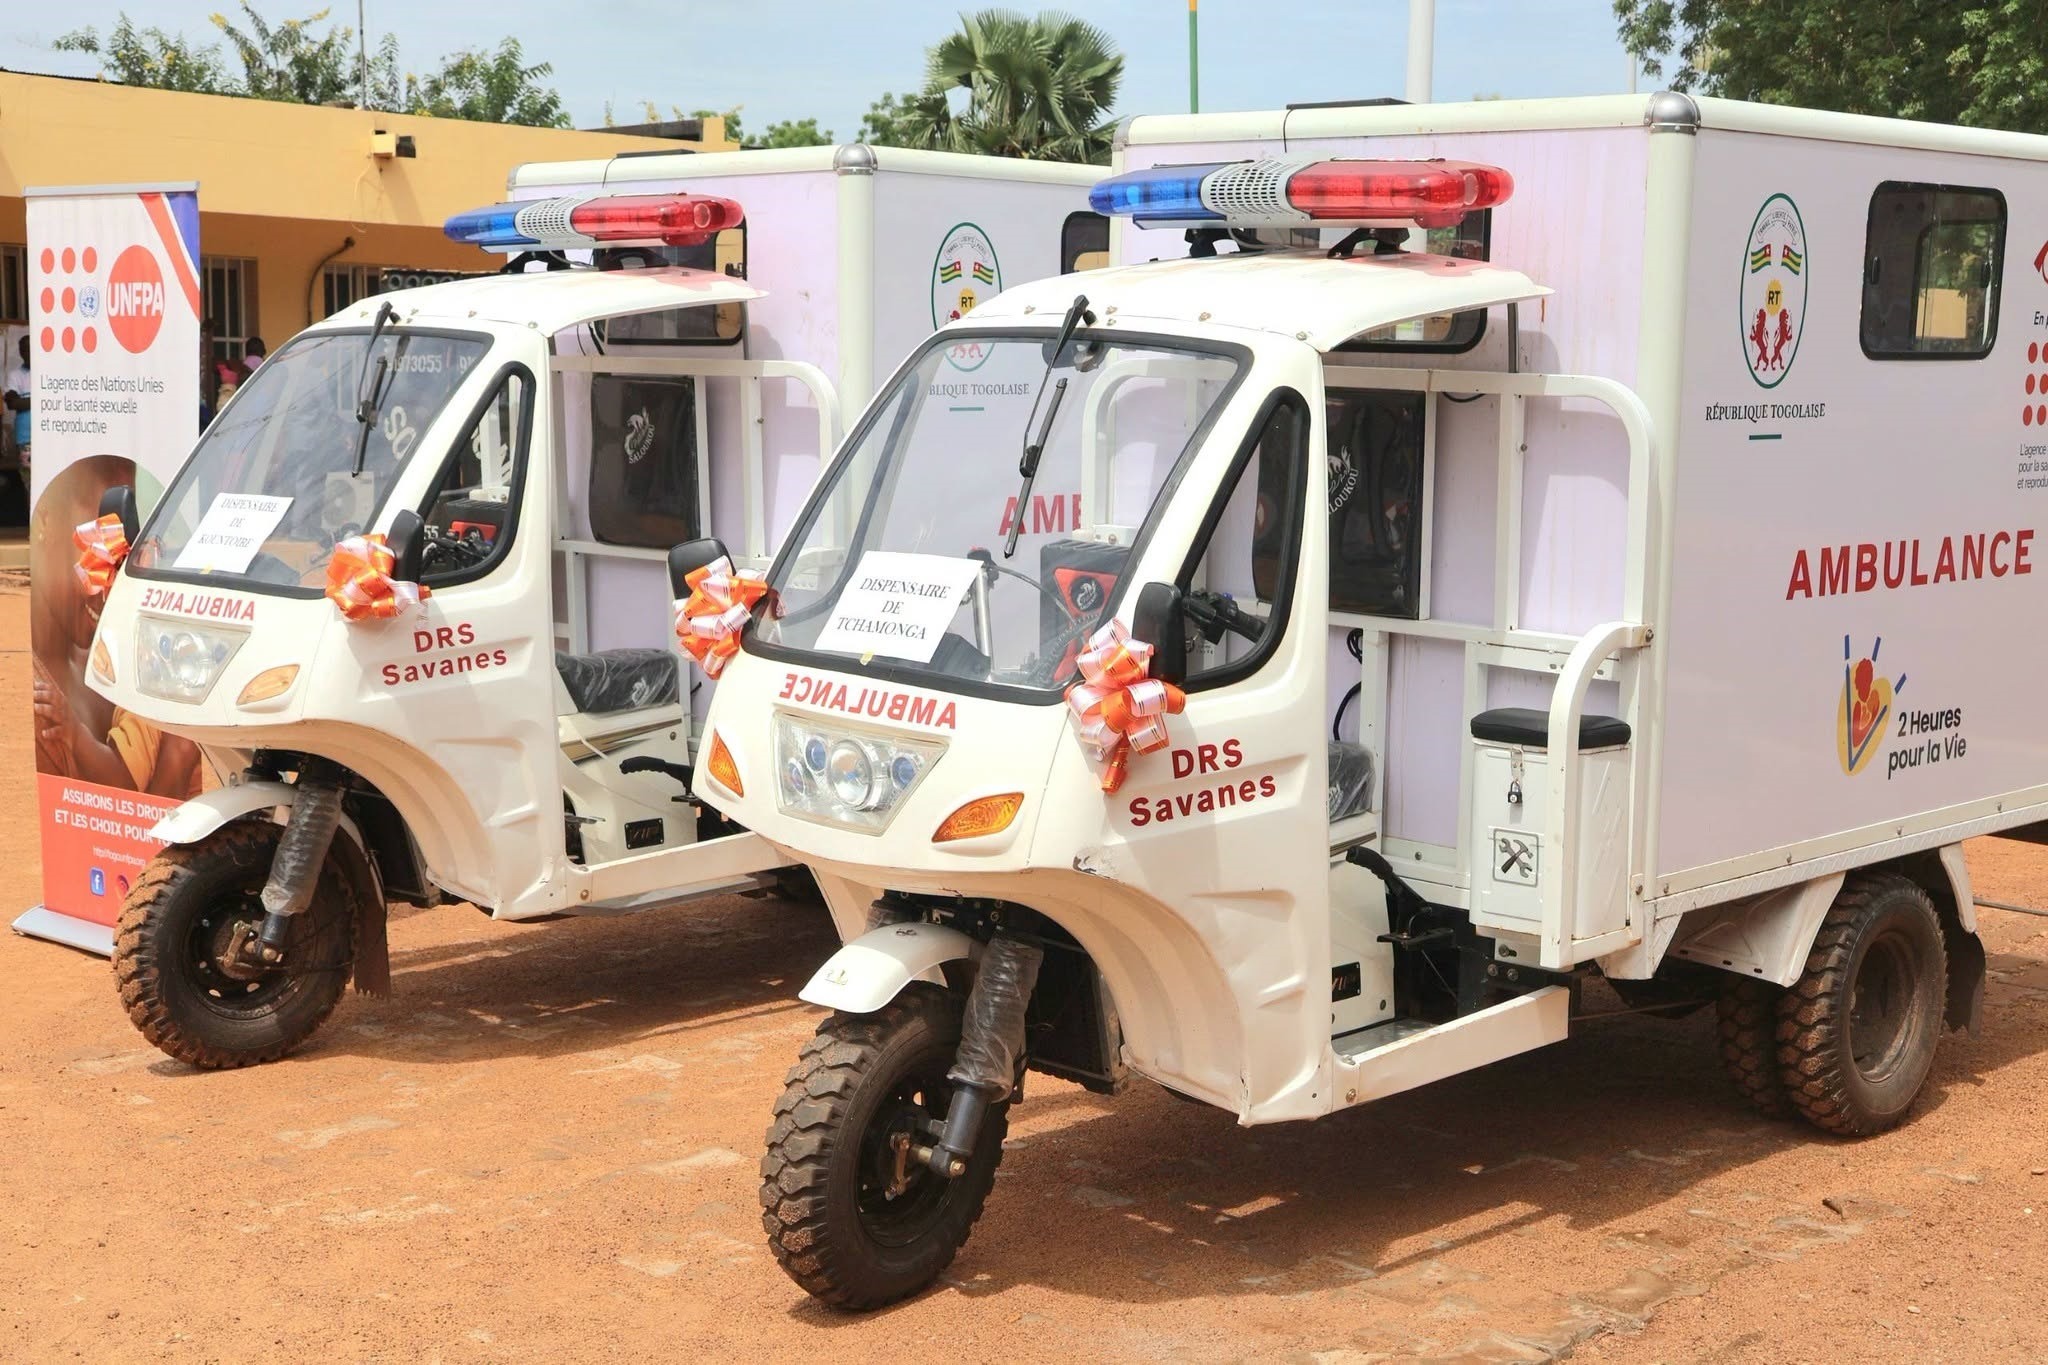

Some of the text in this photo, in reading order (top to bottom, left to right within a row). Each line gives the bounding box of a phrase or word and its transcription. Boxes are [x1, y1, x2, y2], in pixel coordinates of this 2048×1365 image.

[107, 281, 165, 317] UNFPA
[961, 296, 974, 308] RT
[1767, 290, 1781, 305] RT
[2033, 310, 2045, 326] En
[40, 374, 164, 394] L'agence des Nations Unies
[971, 383, 1030, 396] TOGOLAISE
[40, 396, 138, 414] pour la santé sexuelle
[1705, 401, 1826, 424] RÉPUBLIQUE TOGOLAISE
[40, 417, 107, 435] et reproductive
[2019, 443, 2047, 459] L'agence
[2017, 462, 2034, 475] pour
[2034, 459, 2040, 472] la
[1329, 467, 1360, 515] LOUKOU
[2016, 478, 2024, 490] et
[220, 498, 281, 513] DISPENSAIRE
[229, 517, 246, 528] DE
[1785, 529, 2035, 601] AMBULANCE
[859, 577, 951, 599] DISPENSAIRE
[881, 600, 905, 615] DE
[413, 623, 475, 653] DRS
[836, 616, 927, 640] TCHAMONGA
[382, 649, 508, 686] Savanes
[1897, 707, 1962, 737] 2 Heures
[1171, 738, 1243, 780] DRS
[1887, 732, 1967, 781] pour la Vie
[62, 787, 113, 812] ASSURONS
[115, 799, 135, 817] LES
[1129, 775, 1276, 827] Savanes
[55, 809, 69, 824] ET
[70, 811, 88, 829] LES
[89, 816, 122, 837] CHOIX
